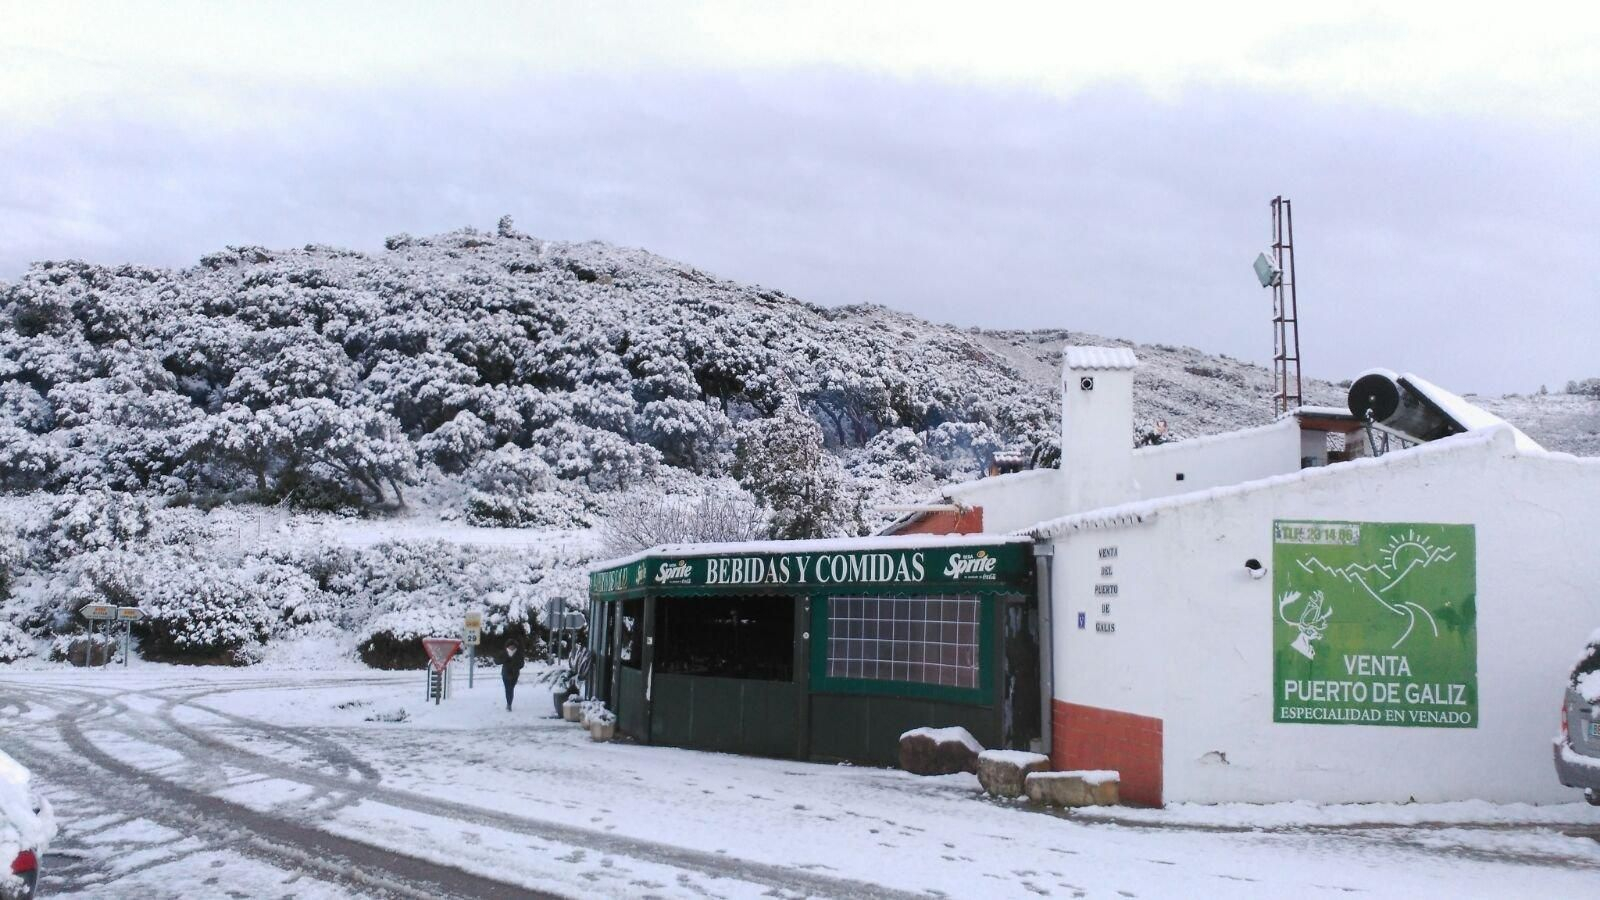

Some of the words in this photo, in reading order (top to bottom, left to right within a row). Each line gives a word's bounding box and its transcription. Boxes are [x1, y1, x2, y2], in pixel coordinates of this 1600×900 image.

[1098, 548, 1118, 558] VENTA
[655, 561, 693, 584] Sprite
[705, 556, 790, 585] BEBIDAS
[795, 556, 809, 583] Y
[815, 552, 926, 583] COMIDAS
[943, 552, 998, 580] Sprite
[1101, 566, 1113, 576] DEL
[1094, 585, 1118, 594] PUERTO
[1101, 604, 1110, 613] DE
[1095, 623, 1115, 632] GALIS
[1344, 655, 1411, 676] VENTA
[1285, 680, 1368, 703] PUERTO
[1372, 683, 1401, 704] DE
[1405, 683, 1467, 705] GALIZ
[1280, 707, 1382, 721] ESPECIALIDAD
[1386, 710, 1405, 722] EN
[1409, 710, 1471, 724] VENADO
